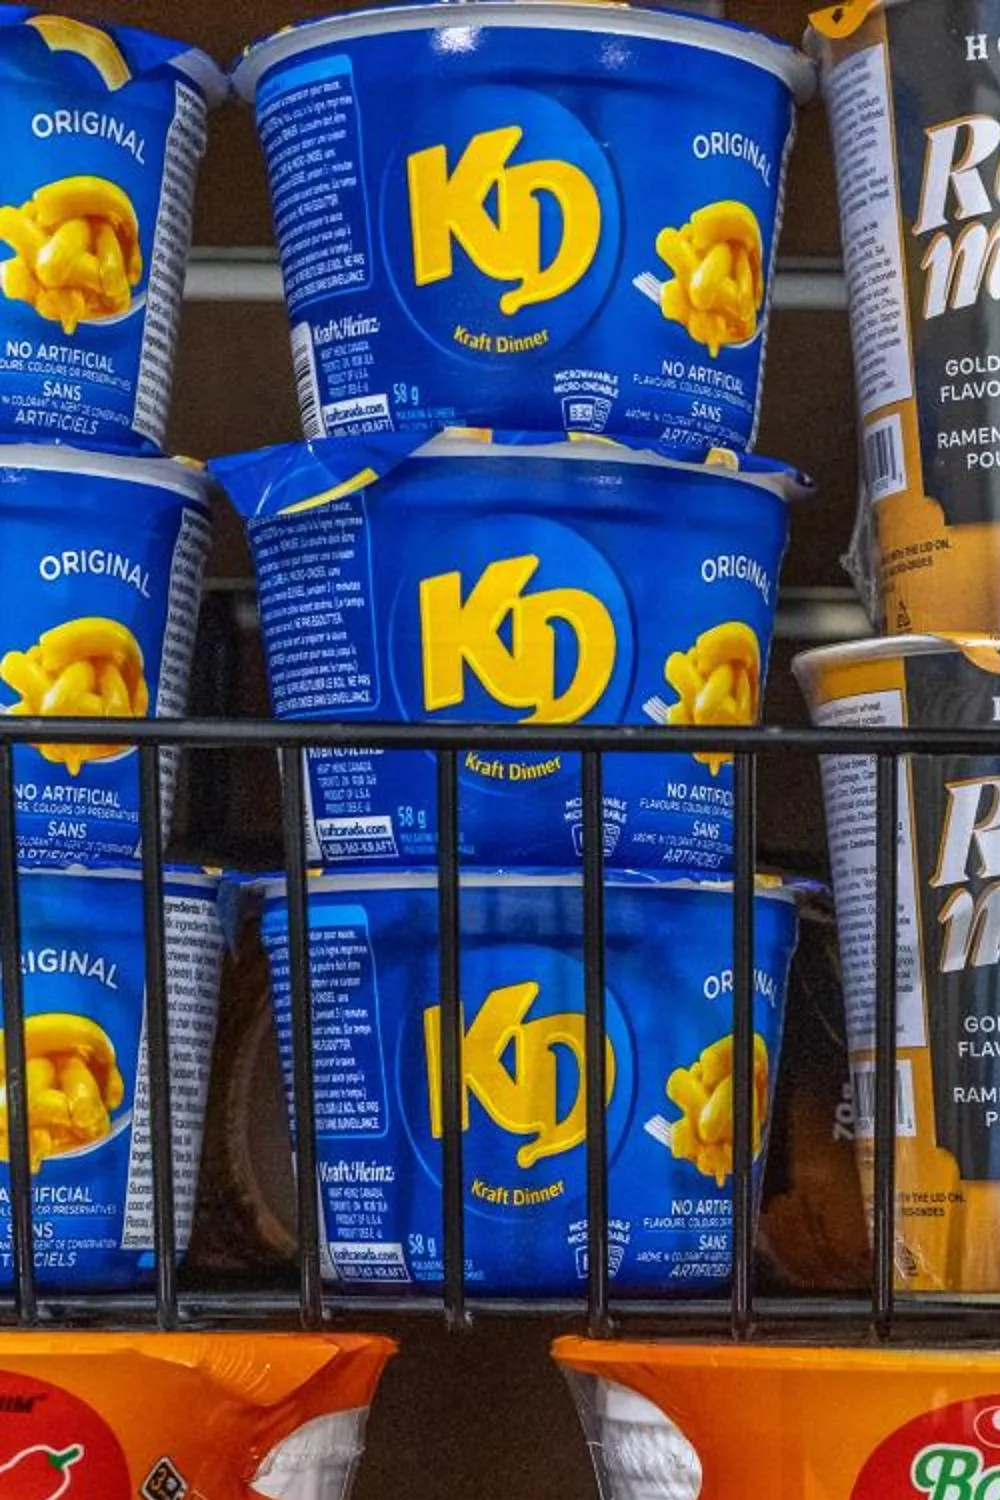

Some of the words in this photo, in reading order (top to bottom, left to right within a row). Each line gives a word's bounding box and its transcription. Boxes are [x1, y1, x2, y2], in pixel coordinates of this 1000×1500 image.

[31, 109, 146, 165] ORIGINAL
[693, 132, 771, 188] ORIGINAL
[407, 126, 600, 316] KD
[454, 324, 491, 353] Kraft
[496, 330, 549, 353] Dinner
[7, 341, 31, 357] NO
[37, 344, 115, 373] ARTIFICIAL
[662, 360, 684, 377] NO
[688, 367, 744, 395] ARTIFICIAL
[43, 381, 82, 401] SANS
[393, 383, 407, 404] 58
[411, 385, 419, 406] g
[15, 410, 99, 435] ARTIFICIELS
[691, 402, 722, 423] SANS
[39, 551, 151, 598] ORIGINAL
[702, 555, 769, 605] ORIGINAL
[420, 554, 616, 724] KD
[465, 752, 504, 778] Kraft
[509, 754, 561, 780] Dinner
[42, 786, 120, 807] ARTIFICIAL
[667, 784, 686, 798] NO
[398, 806, 413, 826] 58
[418, 810, 425, 828] g
[48, 822, 87, 838] SANS
[692, 821, 720, 839] SANS
[471, 1180, 508, 1205] Kraft
[513, 1180, 564, 1205] Dinner
[671, 1200, 691, 1215] NO
[7, 1223, 53, 1238] SNS
[699, 1235, 727, 1251] SANS
[408, 1233, 424, 1254] 58
[428, 1236, 436, 1258] g
